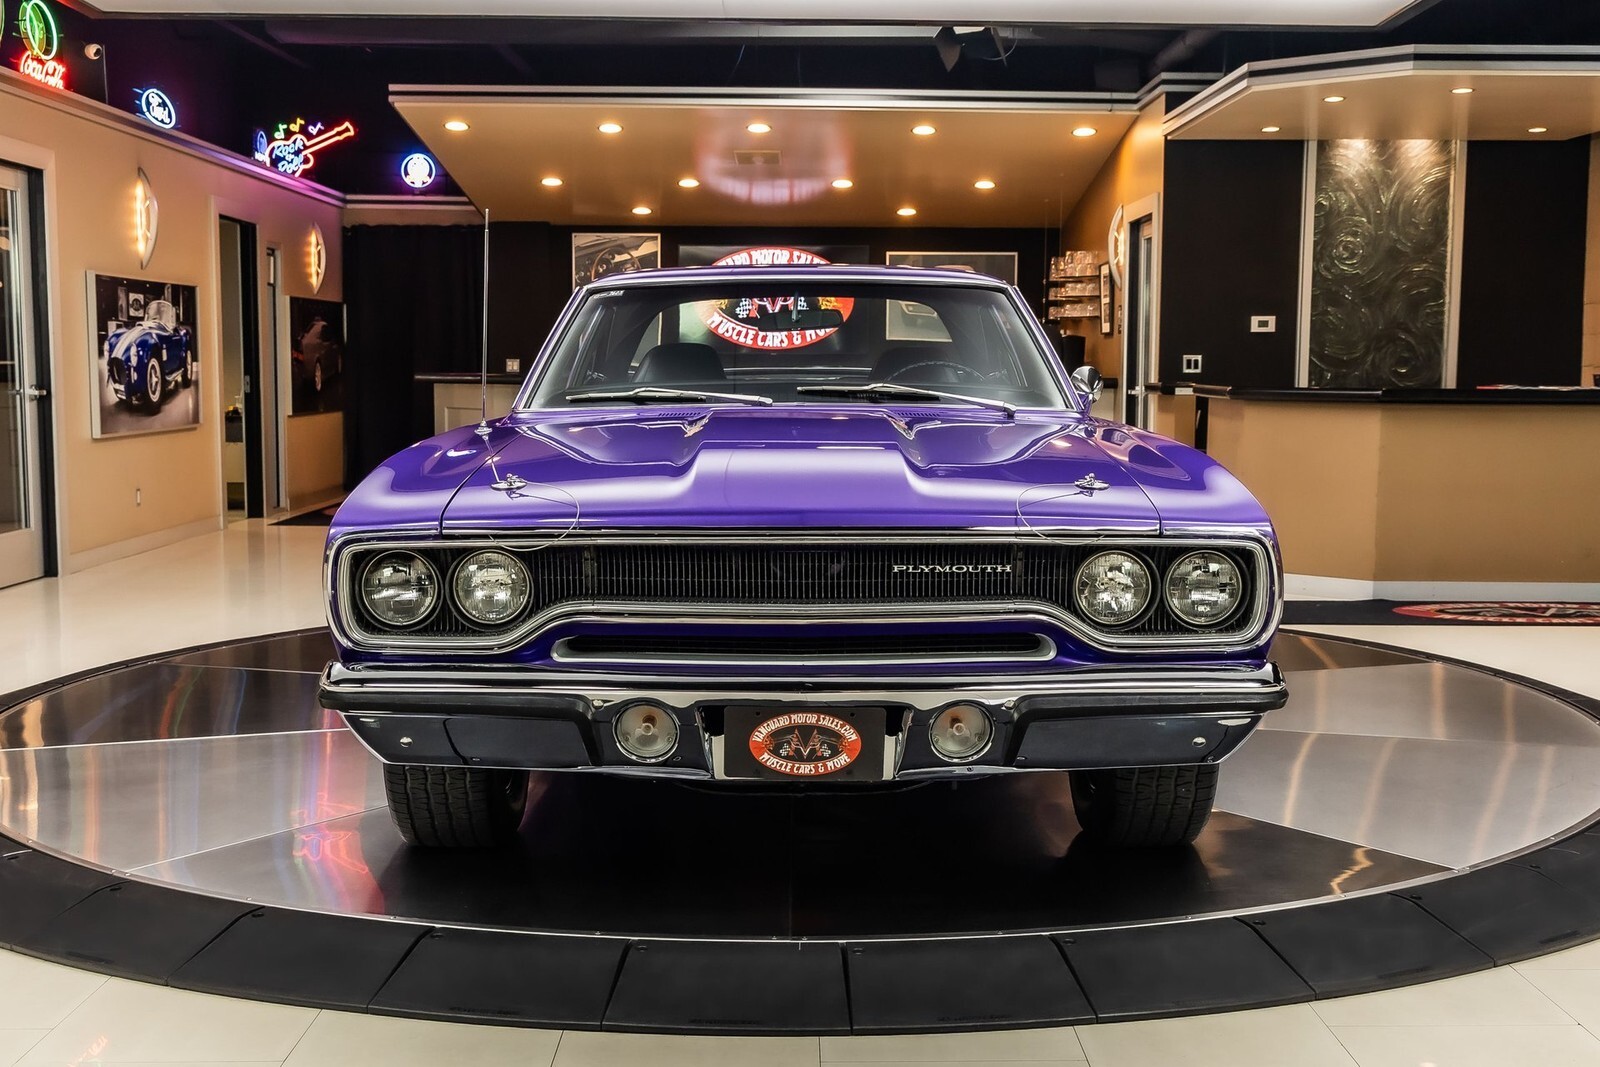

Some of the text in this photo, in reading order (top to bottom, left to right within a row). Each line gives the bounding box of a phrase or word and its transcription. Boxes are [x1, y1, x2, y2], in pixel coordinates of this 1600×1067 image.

[272, 136, 304, 159] Rock
[706, 312, 756, 345] MUSCLE
[757, 331, 789, 347] CARS
[791, 331, 801, 345] &
[892, 565, 1012, 573] PLYMOUTH
[752, 713, 858, 742] VANGUARD MOTOR SALES.COM
[759, 752, 851, 774] MUSCLE CARS & MORE
